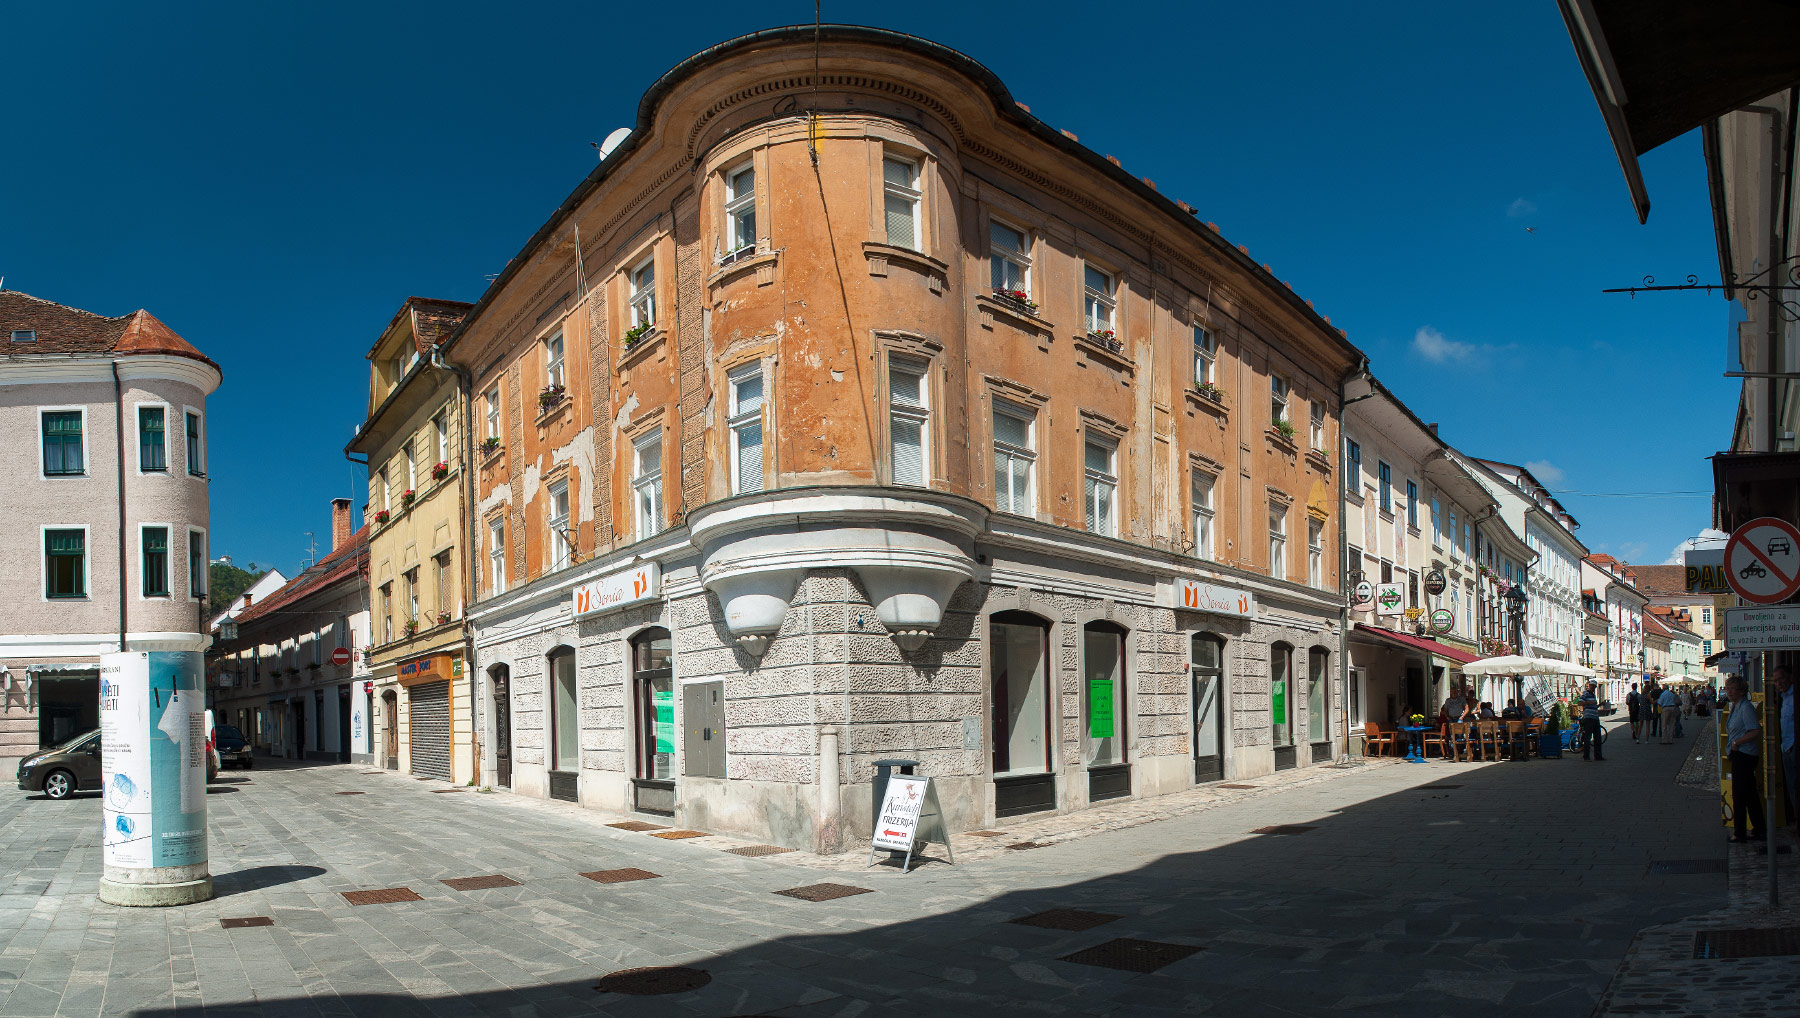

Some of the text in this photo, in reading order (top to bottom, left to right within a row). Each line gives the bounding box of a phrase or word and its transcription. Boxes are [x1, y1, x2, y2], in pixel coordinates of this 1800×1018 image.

[591, 581, 624, 609] Sonia
[1200, 586, 1231, 610] Sonia
[1743, 613, 1775, 622] Dovoljeno
[1730, 624, 1776, 633] intervencijska
[1780, 623, 1800, 631] vozila
[1737, 636, 1757, 644] vozila
[883, 816, 914, 828] FRIZERIJA
